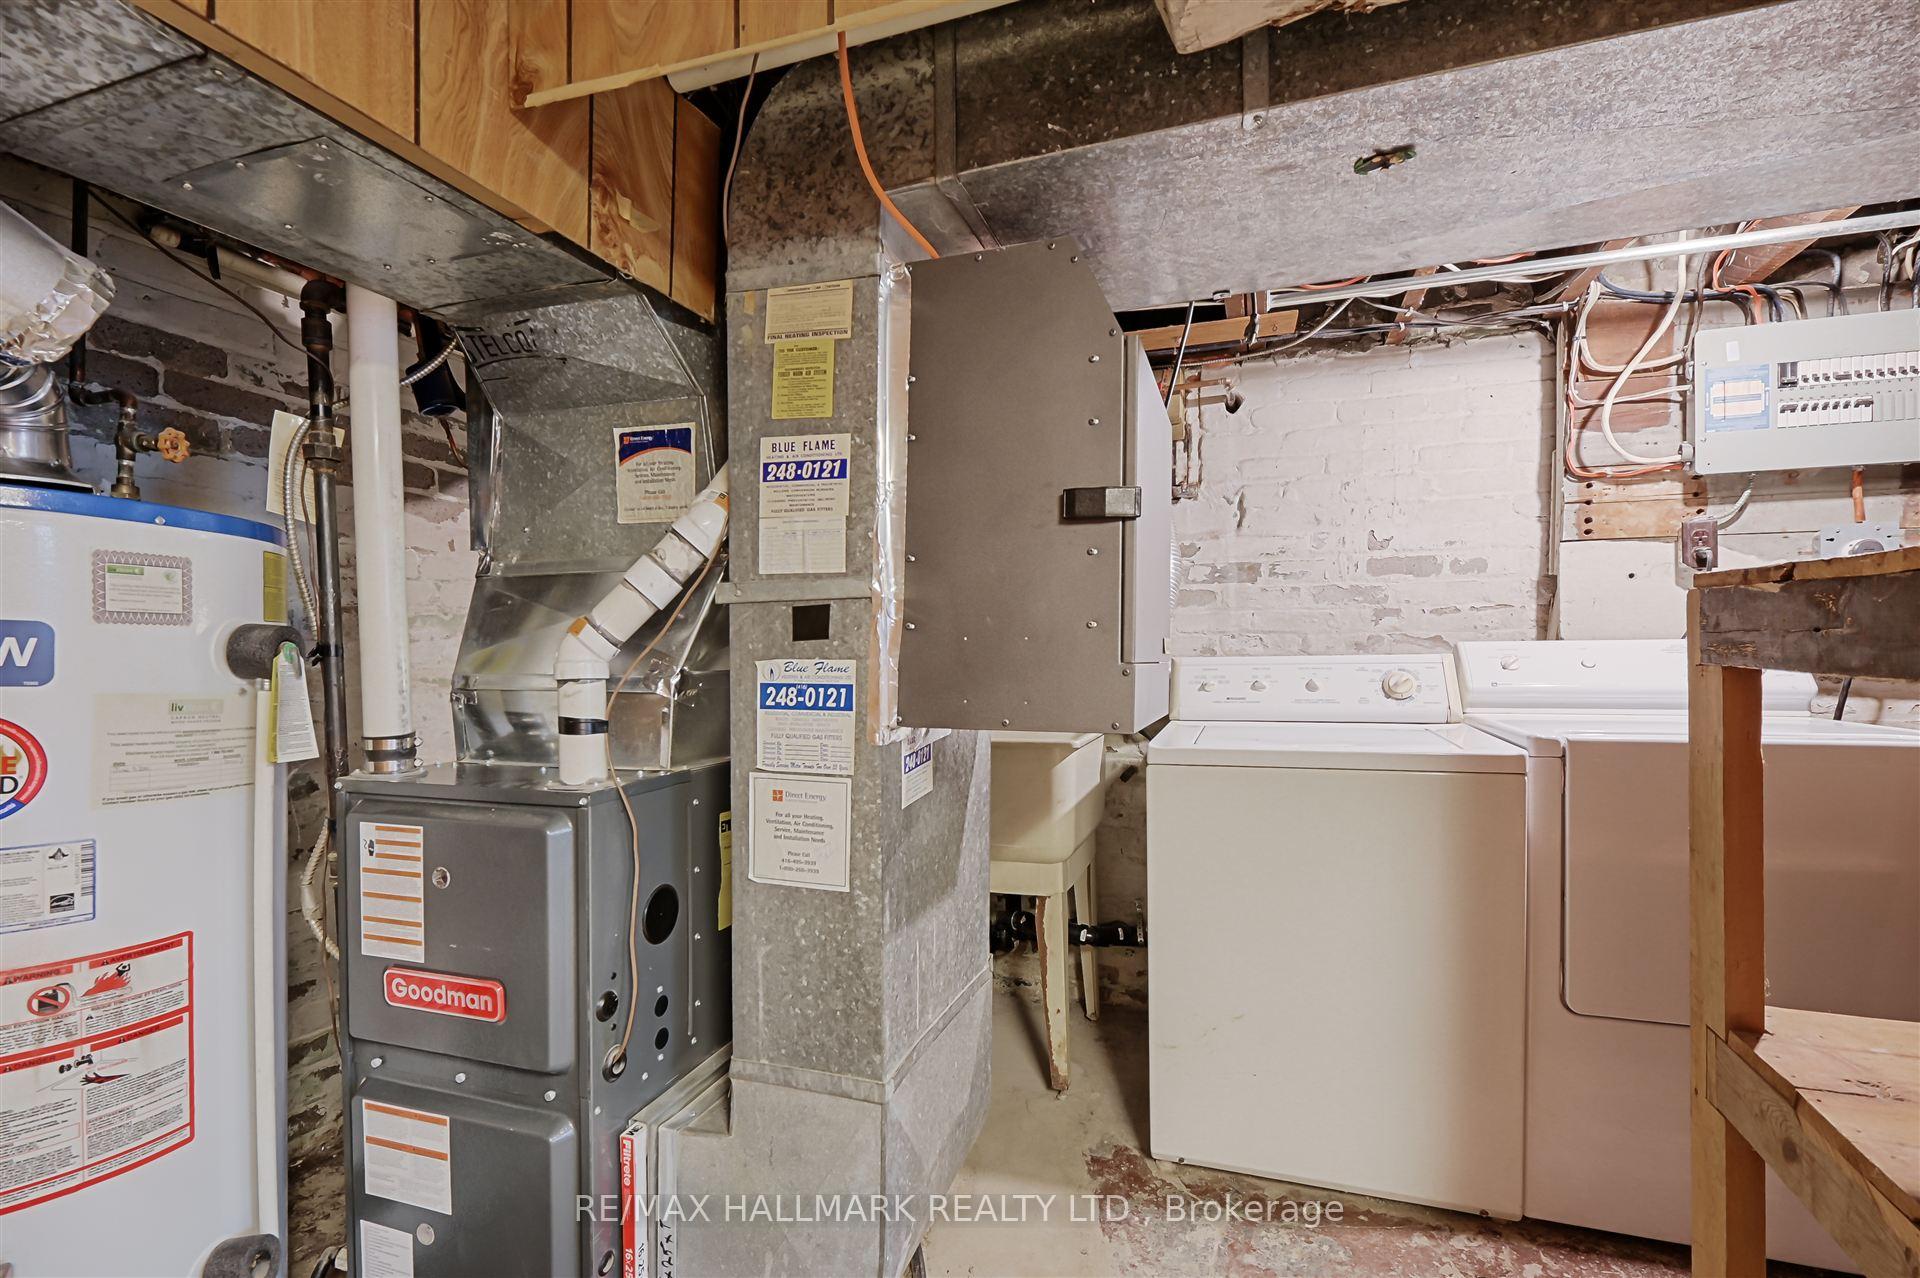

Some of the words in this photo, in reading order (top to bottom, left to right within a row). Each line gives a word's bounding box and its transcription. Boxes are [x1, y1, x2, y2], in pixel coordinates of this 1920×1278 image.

[812, 329, 848, 337] INSPECTION
[771, 442, 796, 452] BLUE
[803, 440, 836, 451] FLAME
[784, 661, 809, 673] Blue
[814, 661, 850, 675] Flame
[766, 686, 847, 708] 248-0121
[171, 702, 184, 712] liv
[785, 791, 803, 799] Direct
[805, 792, 827, 801] Energy
[794, 828, 824, 836] Maintenance
[13, 969, 62, 983] WARNING
[391, 977, 493, 1012] Goodman
[127, 1025, 161, 1041] DANGER
[13, 1055, 57, 1069] DANGER
[626, 1125, 643, 1136] 3M
